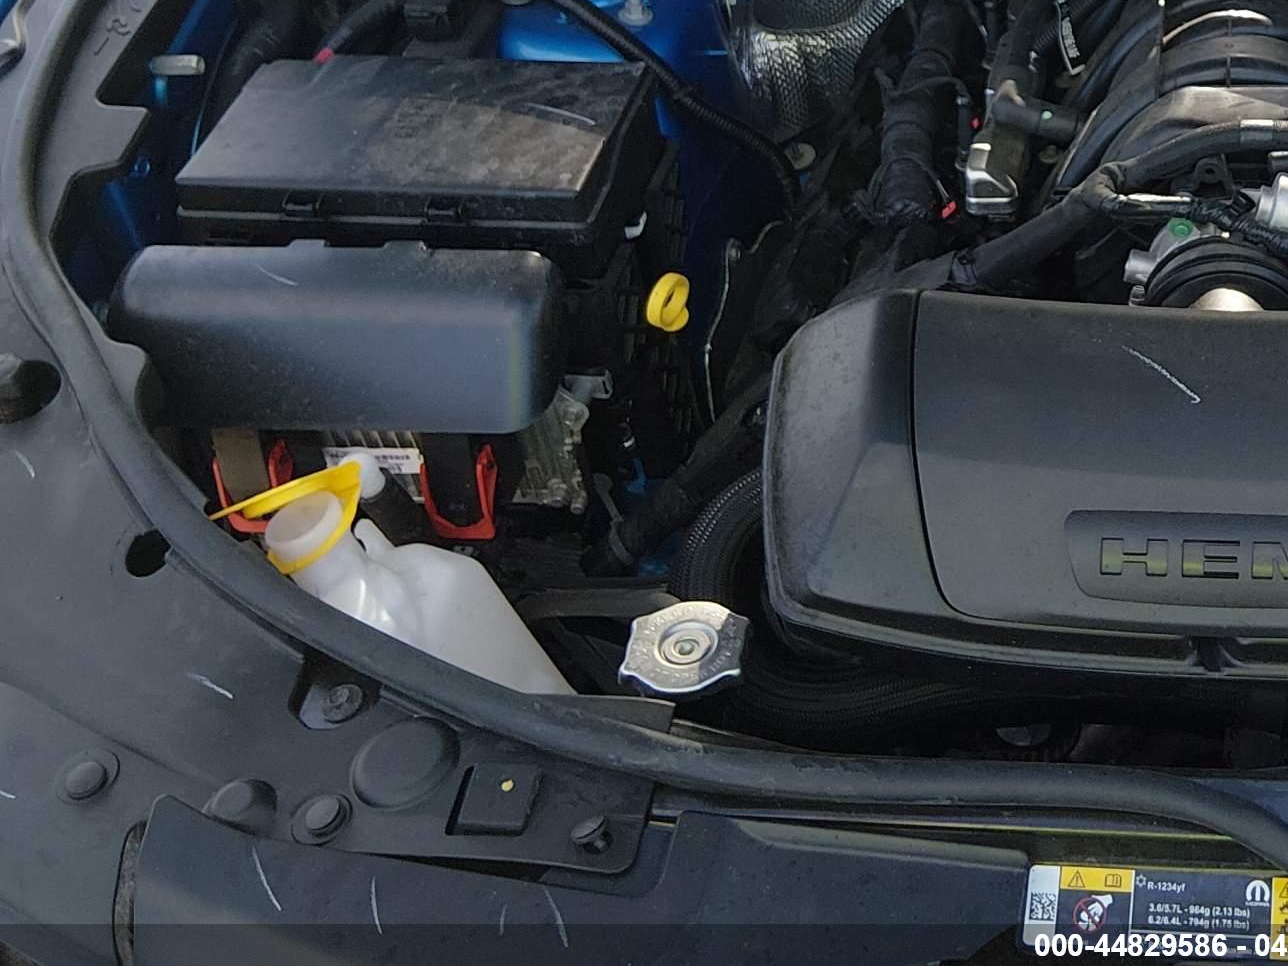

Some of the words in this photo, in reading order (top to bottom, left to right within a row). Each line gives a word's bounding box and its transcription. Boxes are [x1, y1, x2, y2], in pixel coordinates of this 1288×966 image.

[1146, 881, 1186, 894] R-1234yf
[1148, 903, 1183, 914] 3.6/5.7L
[1212, 906, 1232, 917] (2.13
[1233, 907, 1250, 919] lbs)
[1147, 915, 1182, 925] 6.2/6.4L
[1188, 916, 1210, 929] 794g
[1211, 918, 1232, 929] (1.75
[1233, 919, 1250, 931] lbs)
